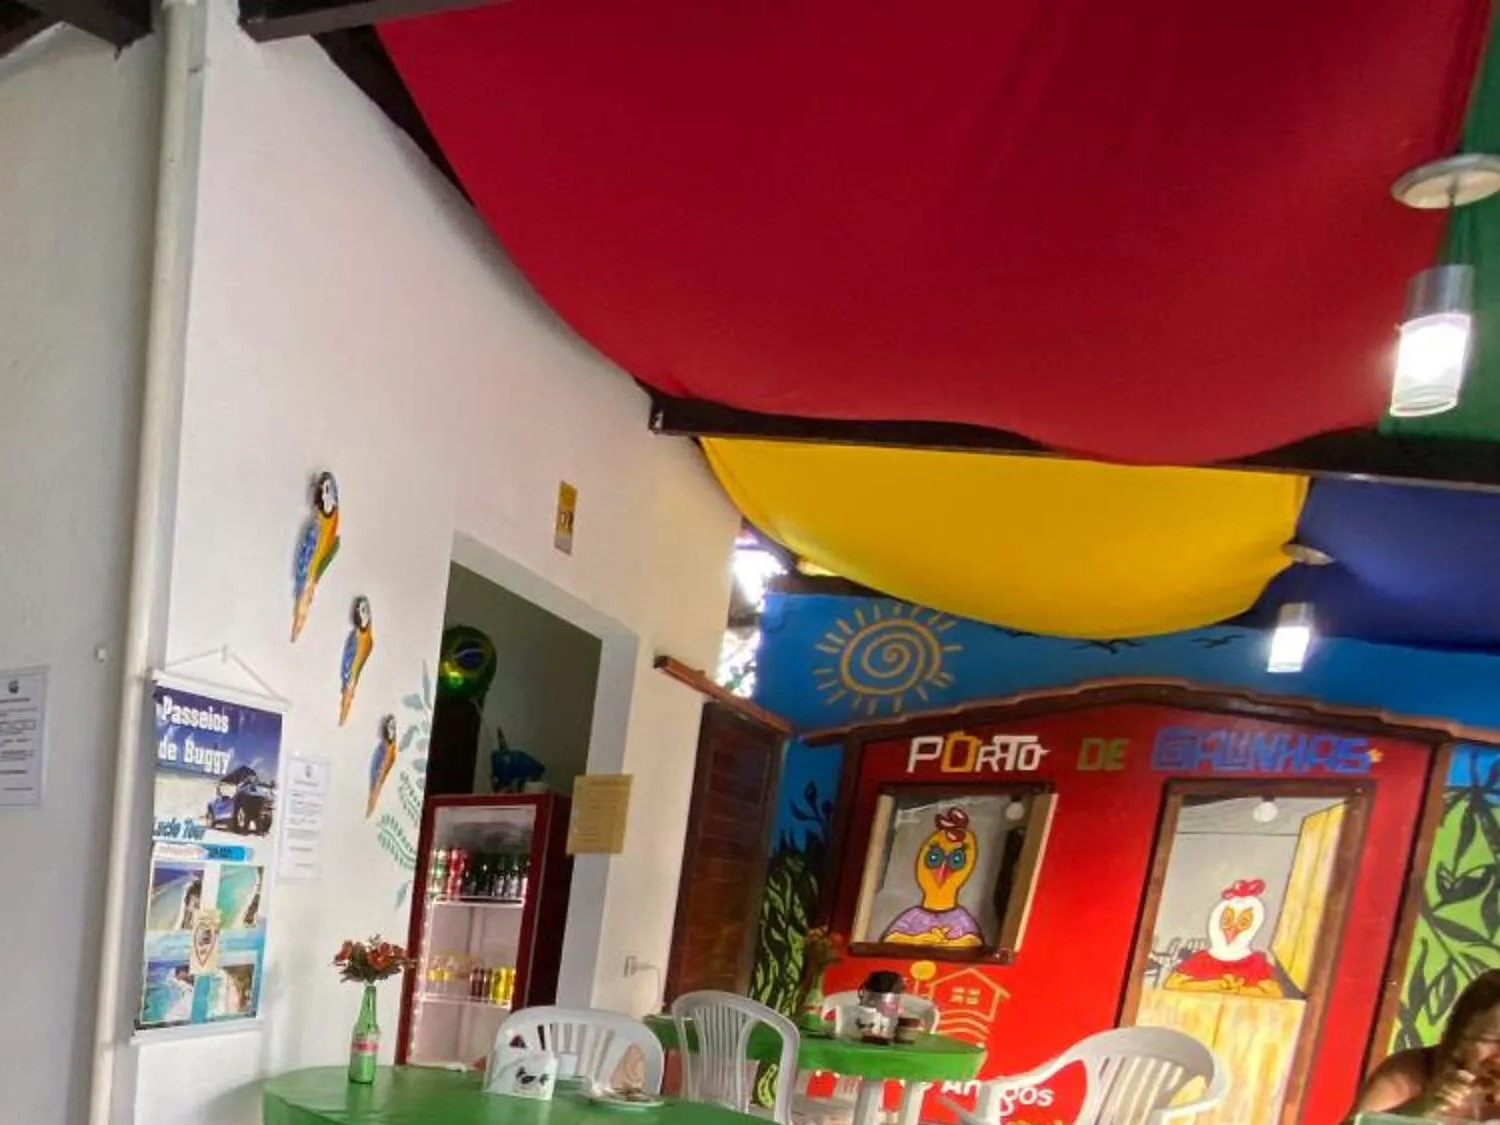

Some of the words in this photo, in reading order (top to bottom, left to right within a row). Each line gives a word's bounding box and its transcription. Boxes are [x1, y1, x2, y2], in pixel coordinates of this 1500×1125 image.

[161, 695, 229, 733] Passeios
[158, 734, 177, 761] de
[183, 738, 232, 775] Buggy
[906, 732, 1050, 773] PORTO
[1077, 738, 1129, 770] DE
